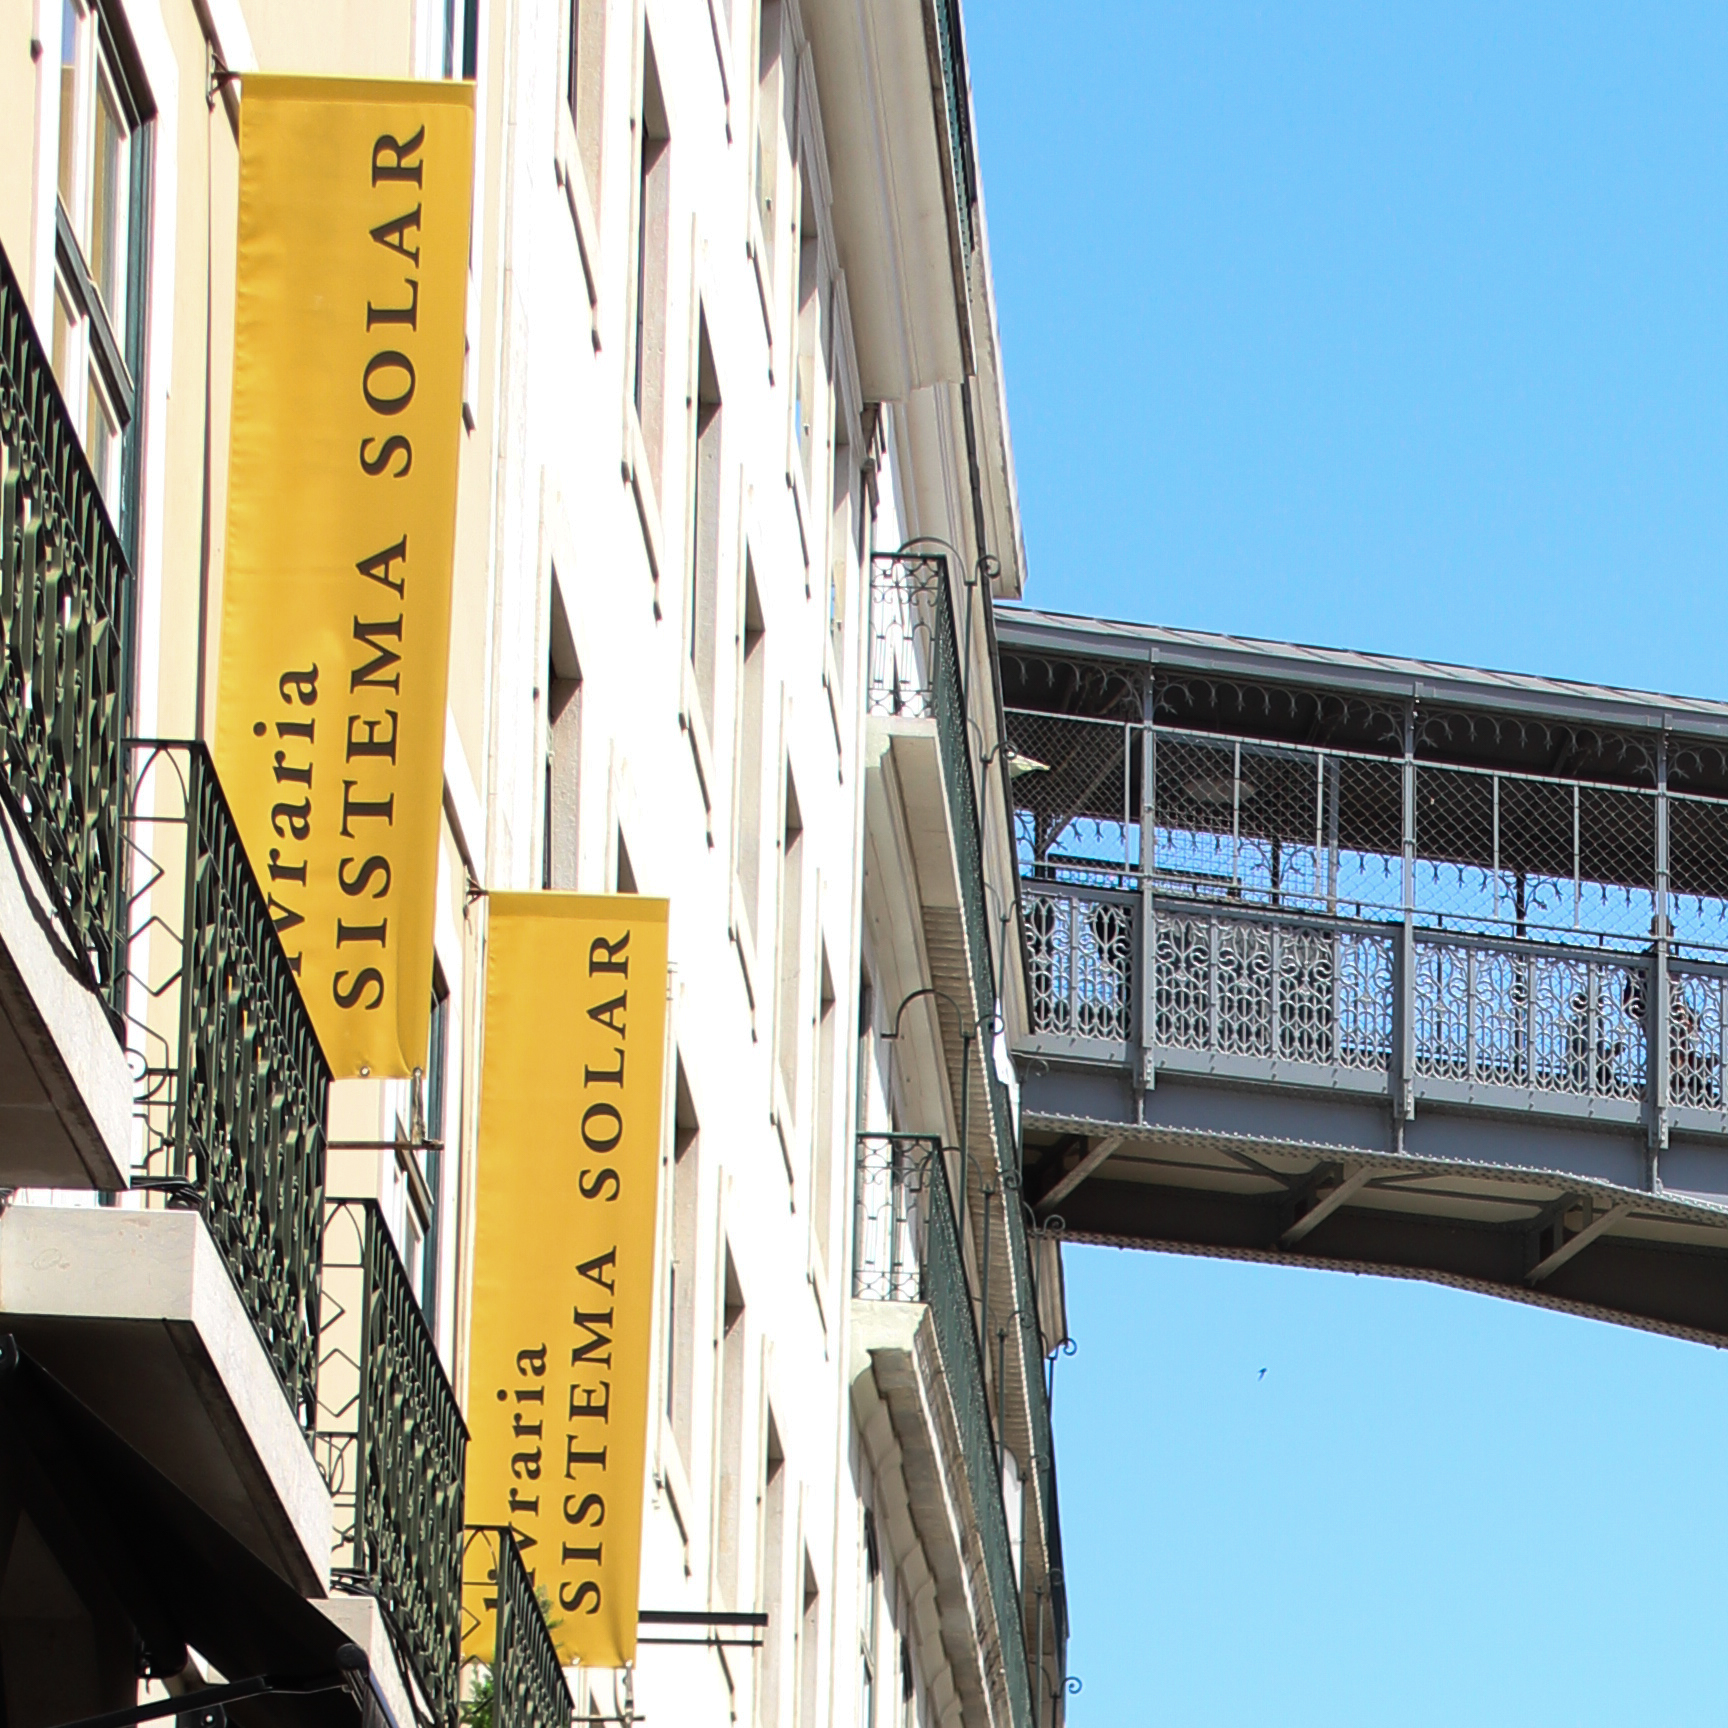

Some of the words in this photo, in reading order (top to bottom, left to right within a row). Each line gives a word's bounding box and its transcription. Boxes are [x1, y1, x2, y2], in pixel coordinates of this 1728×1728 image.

[360, 122, 427, 480] SOLAR
[251, 661, 320, 977] vraria
[333, 533, 408, 1012] SISTEMA
[578, 928, 632, 1204] SOLAR
[484, 1341, 547, 1611] vraria
[559, 1244, 618, 1616] SISTEMA
